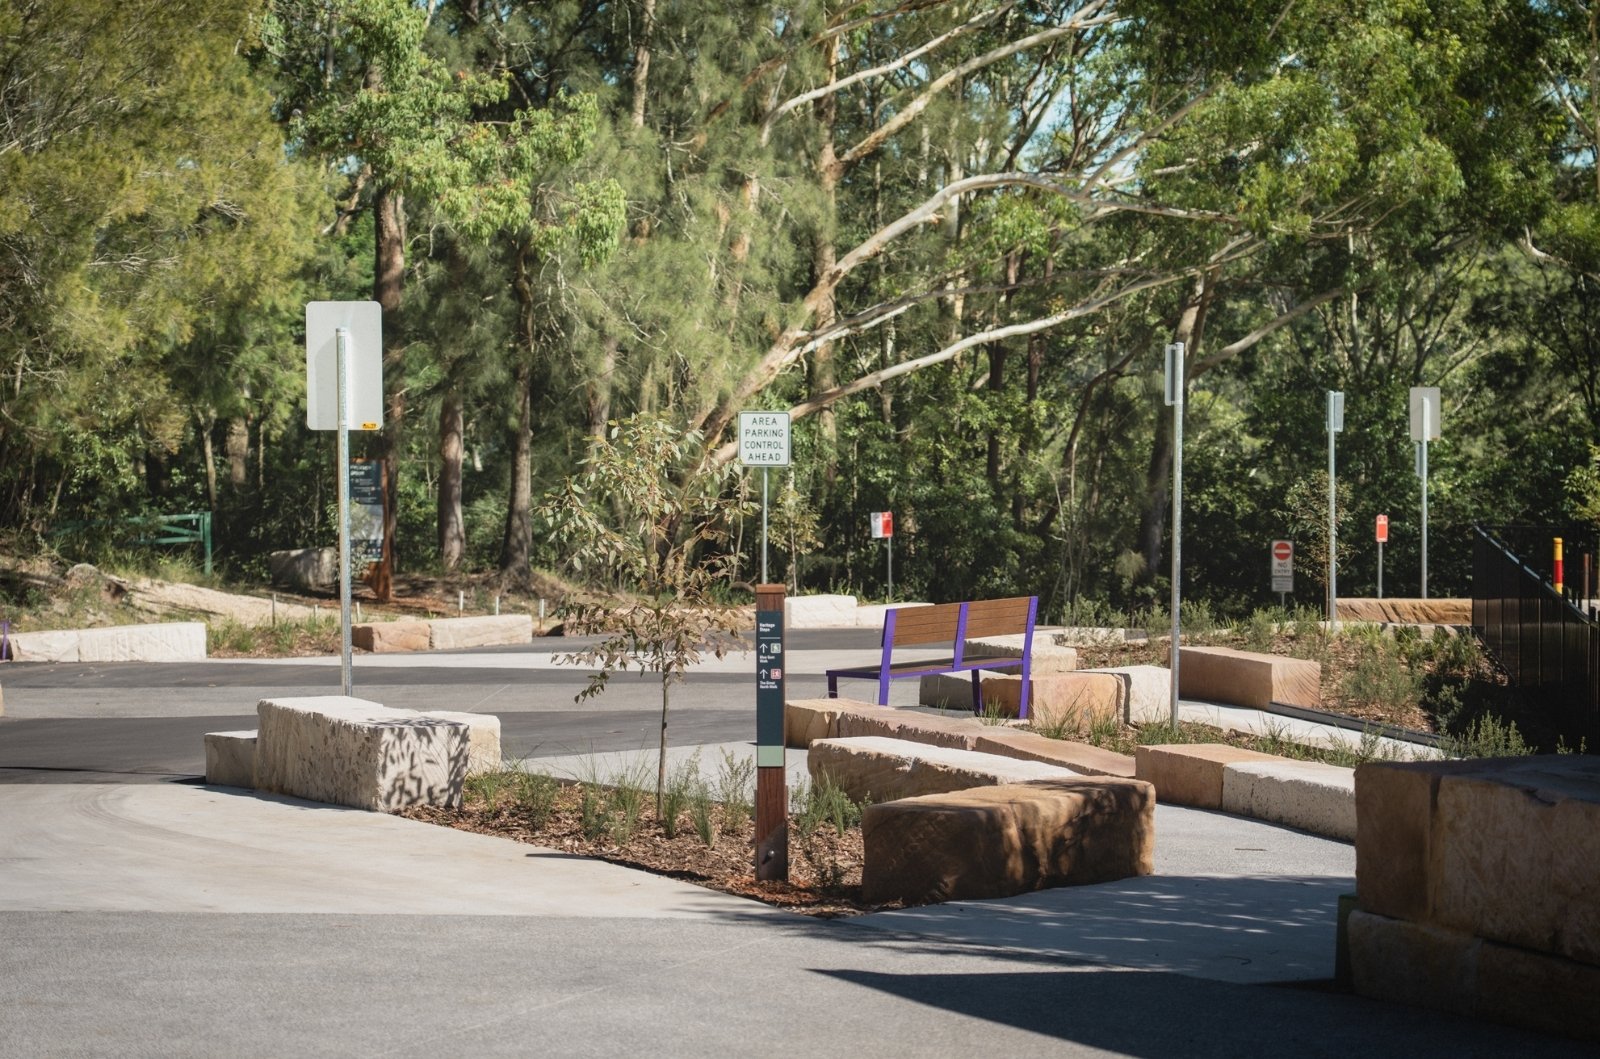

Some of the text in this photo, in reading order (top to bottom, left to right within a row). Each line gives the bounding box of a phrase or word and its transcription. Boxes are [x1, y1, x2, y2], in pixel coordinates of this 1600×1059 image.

[752, 417, 777, 425] AREA
[745, 429, 784, 438] PARKING
[744, 441, 784, 450] CONTROL
[748, 453, 781, 461] AHEAD
